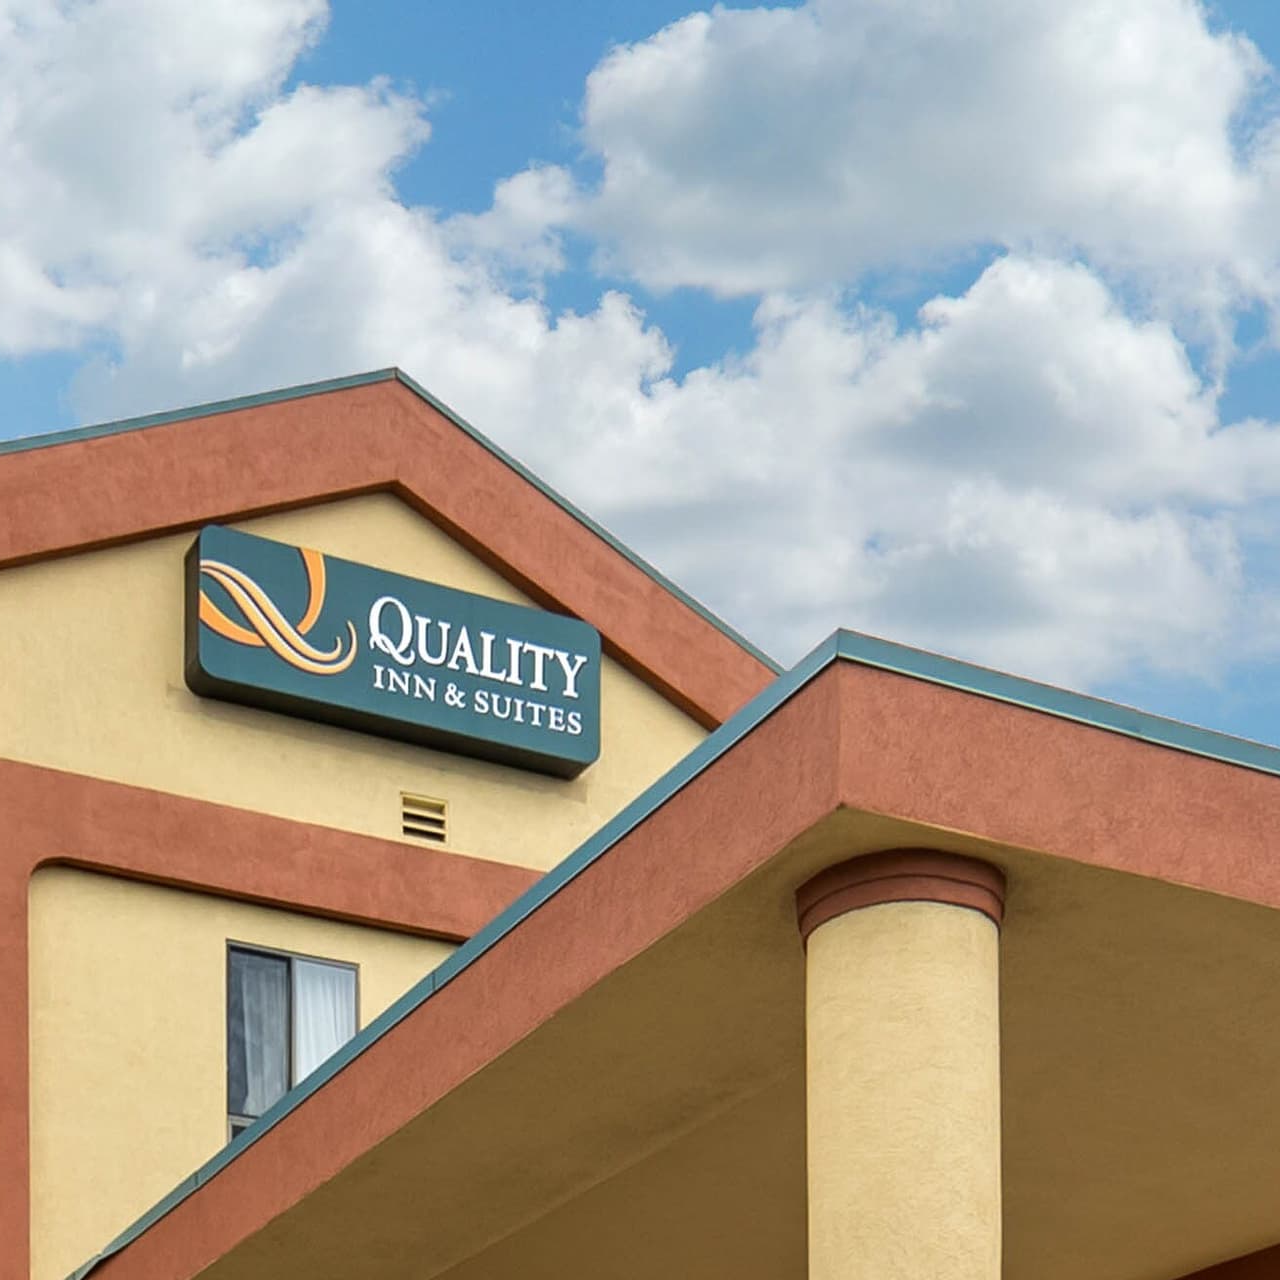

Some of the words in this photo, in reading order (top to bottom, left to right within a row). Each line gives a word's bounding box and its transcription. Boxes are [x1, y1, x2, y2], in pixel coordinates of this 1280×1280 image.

[369, 596, 588, 699] QUALITY
[373, 664, 436, 702] INN
[444, 682, 466, 709] &
[474, 690, 583, 735] SUITES
